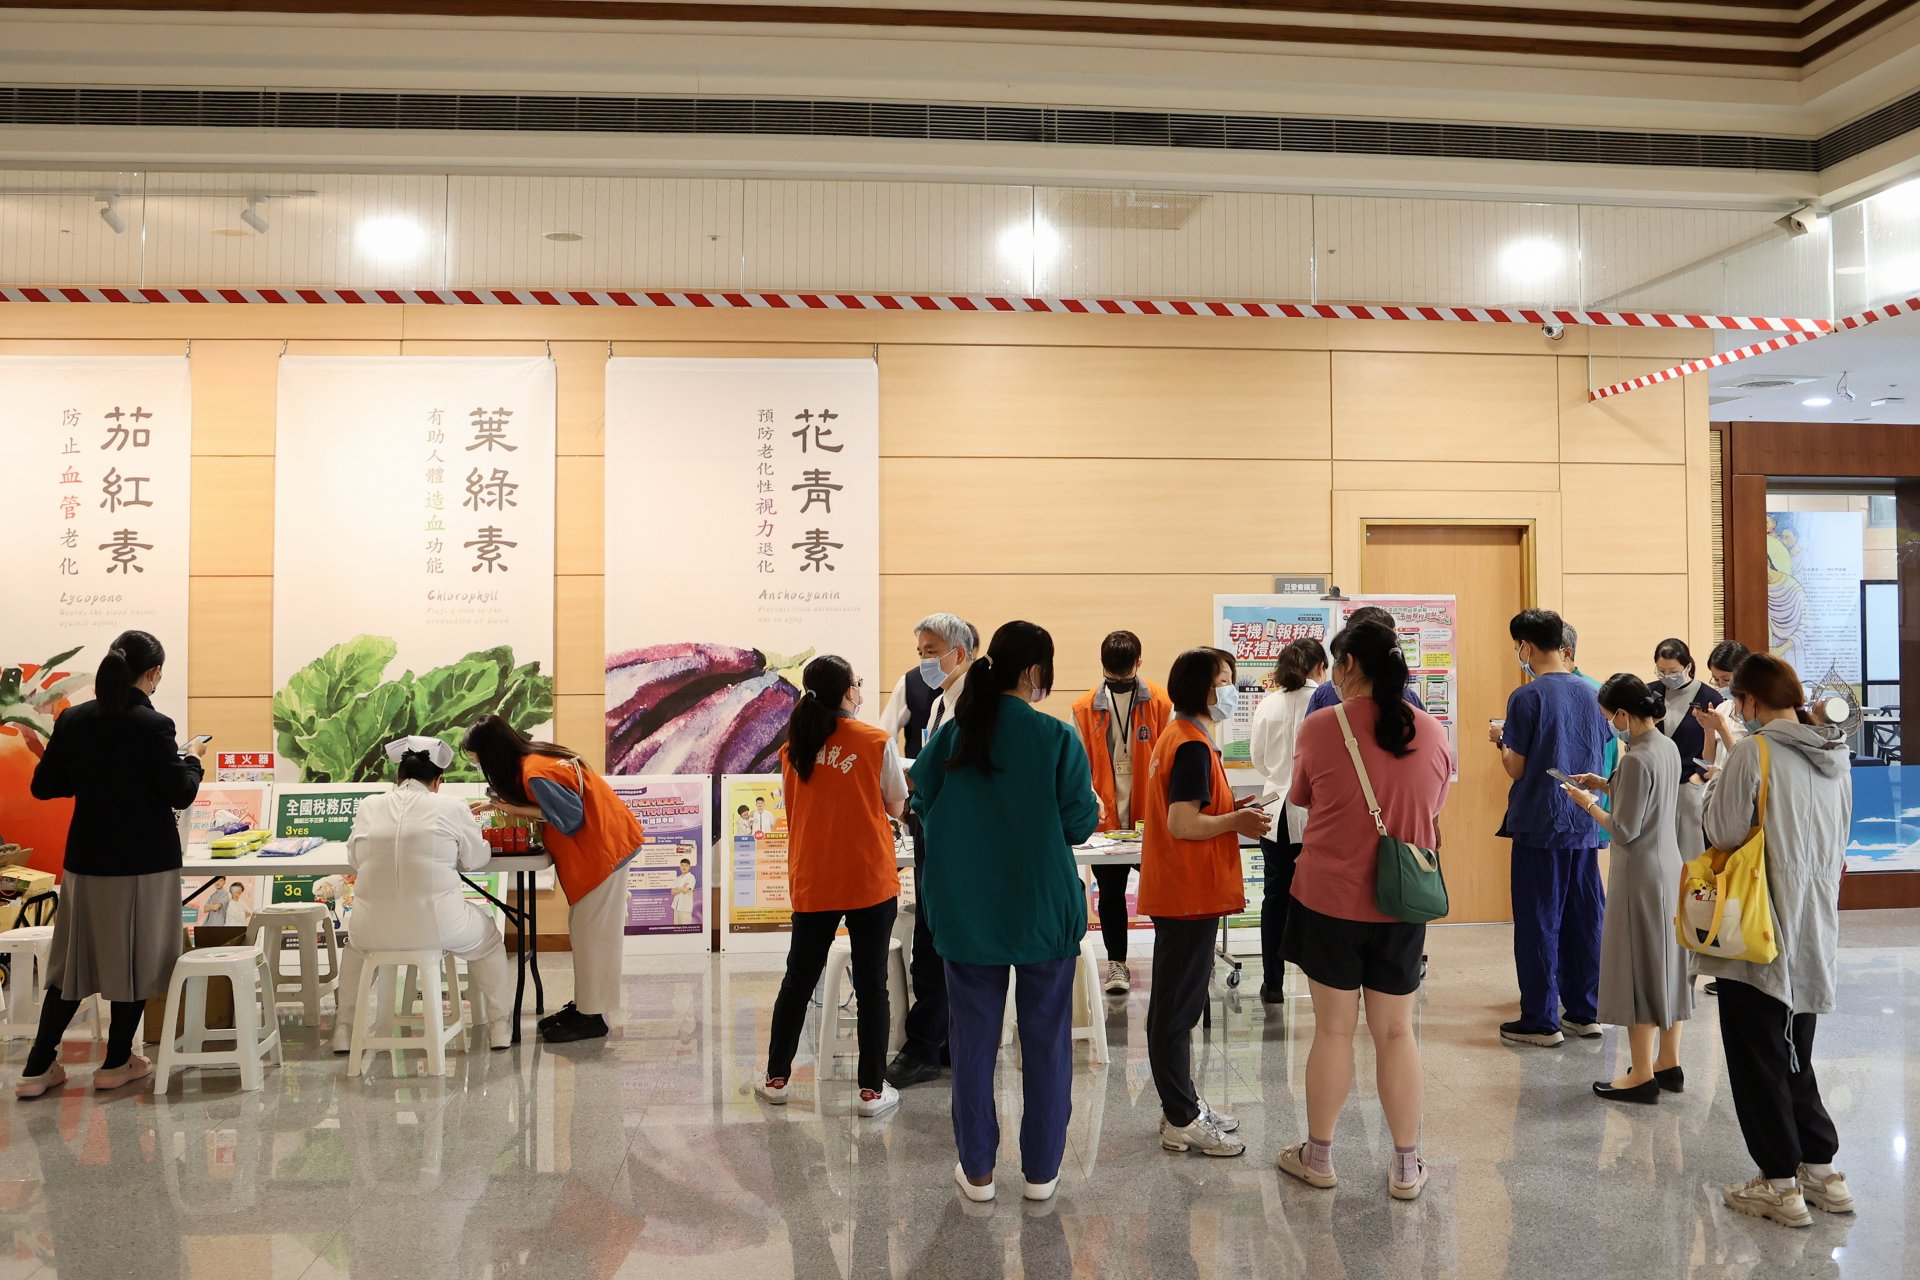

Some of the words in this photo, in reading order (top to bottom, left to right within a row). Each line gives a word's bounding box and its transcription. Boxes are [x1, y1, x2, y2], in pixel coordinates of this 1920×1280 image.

[59, 408, 83, 575] 防止血管老化
[99, 406, 154, 575] 茄紅素
[424, 408, 446, 574] 有助人體造血功能
[462, 407, 519, 573] 葉綠素
[755, 408, 777, 573] 預防老化性視力退化
[791, 408, 844, 573] 花青素
[60, 592, 123, 605] Lycopene
[427, 590, 499, 604] Chlorophyll
[758, 589, 841, 602] Anthocyanin
[1237, 640, 1291, 659] 好禮歡
[224, 754, 269, 765] 滅火器
[286, 825, 309, 836] 3YES
